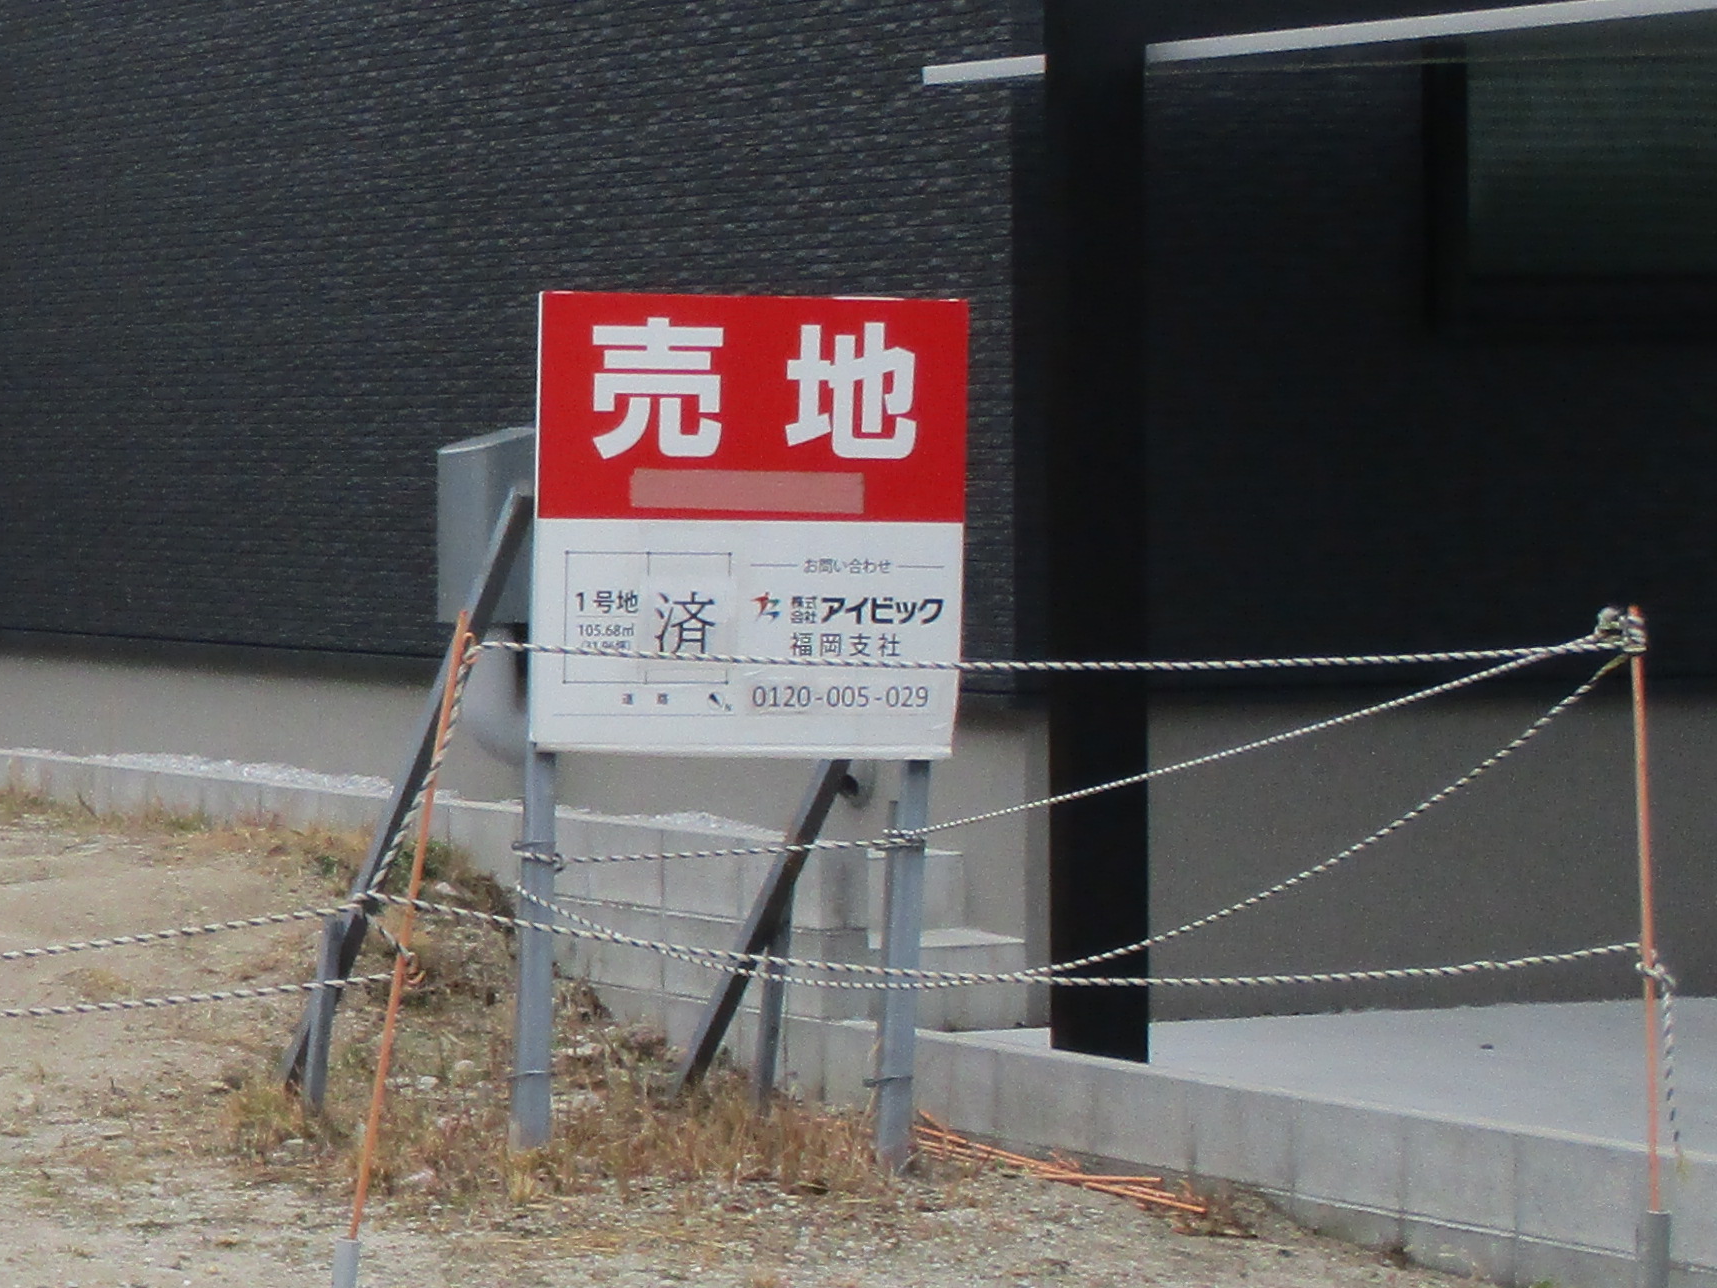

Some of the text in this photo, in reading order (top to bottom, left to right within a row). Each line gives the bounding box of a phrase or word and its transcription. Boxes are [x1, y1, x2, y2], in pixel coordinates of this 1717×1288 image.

[592, 316, 917, 460] 売地
[803, 559, 891, 574] お問い合わせ
[575, 590, 638, 614] 1号地
[821, 597, 944, 625] アイビック
[654, 591, 716, 654] 済
[790, 632, 901, 657] 福岡支社
[752, 686, 929, 708] 0120-005-029
